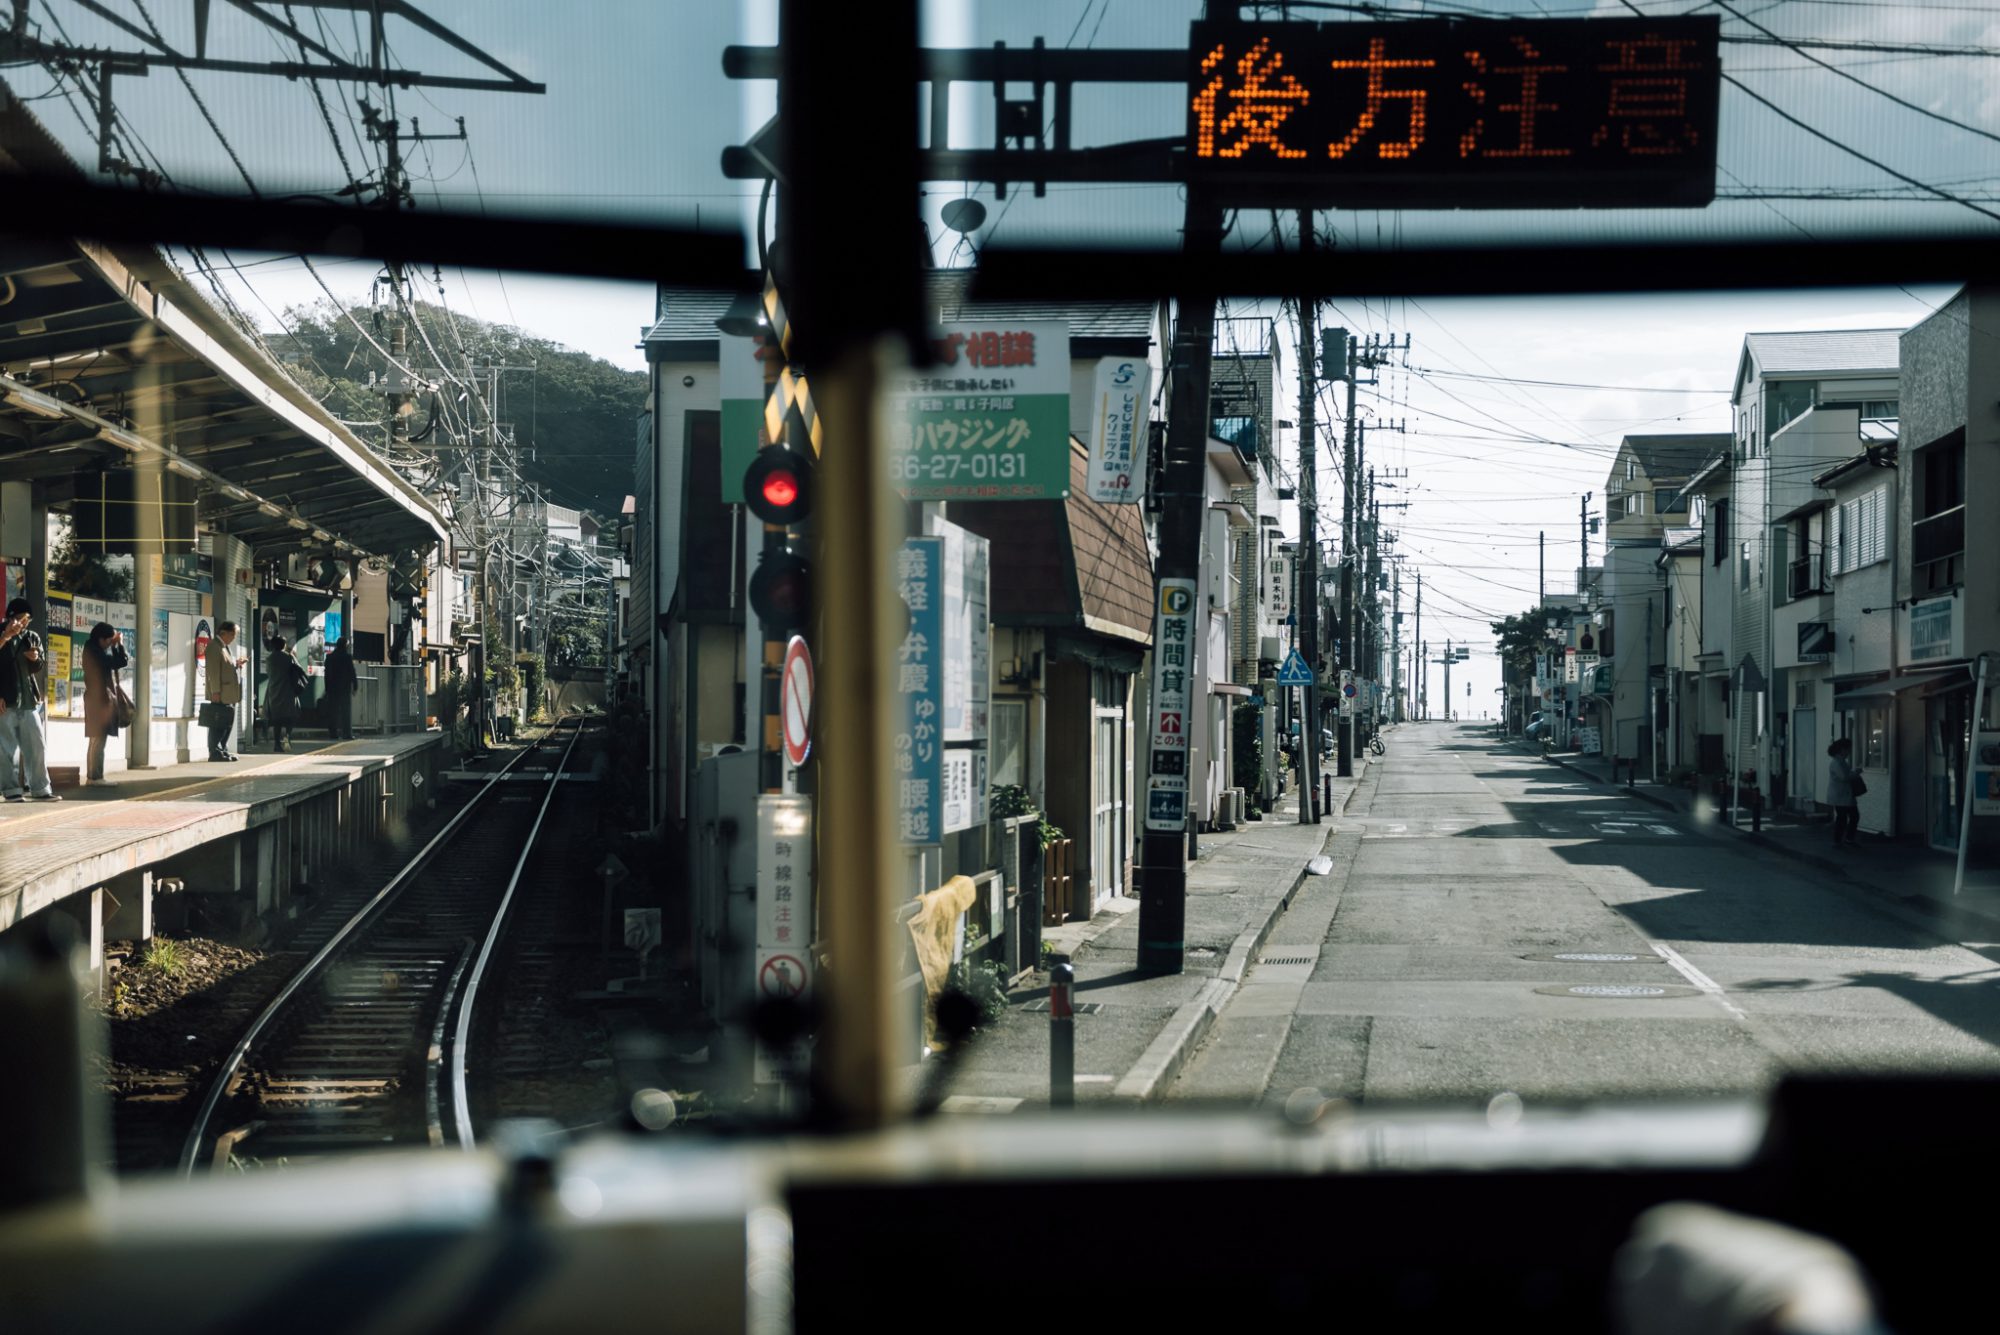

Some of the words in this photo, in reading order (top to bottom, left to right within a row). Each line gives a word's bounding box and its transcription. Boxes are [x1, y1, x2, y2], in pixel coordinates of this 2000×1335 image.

[1192, 34, 1703, 158] 後方注意
[1104, 413, 1118, 460] クリニック
[897, 549, 929, 693] 義経・弁慶
[1173, 592, 1187, 611] P
[1161, 618, 1187, 694] 時間貸
[914, 699, 935, 762] ゆかり
[1154, 736, 1186, 746] この先
[899, 779, 930, 841] 腰越
